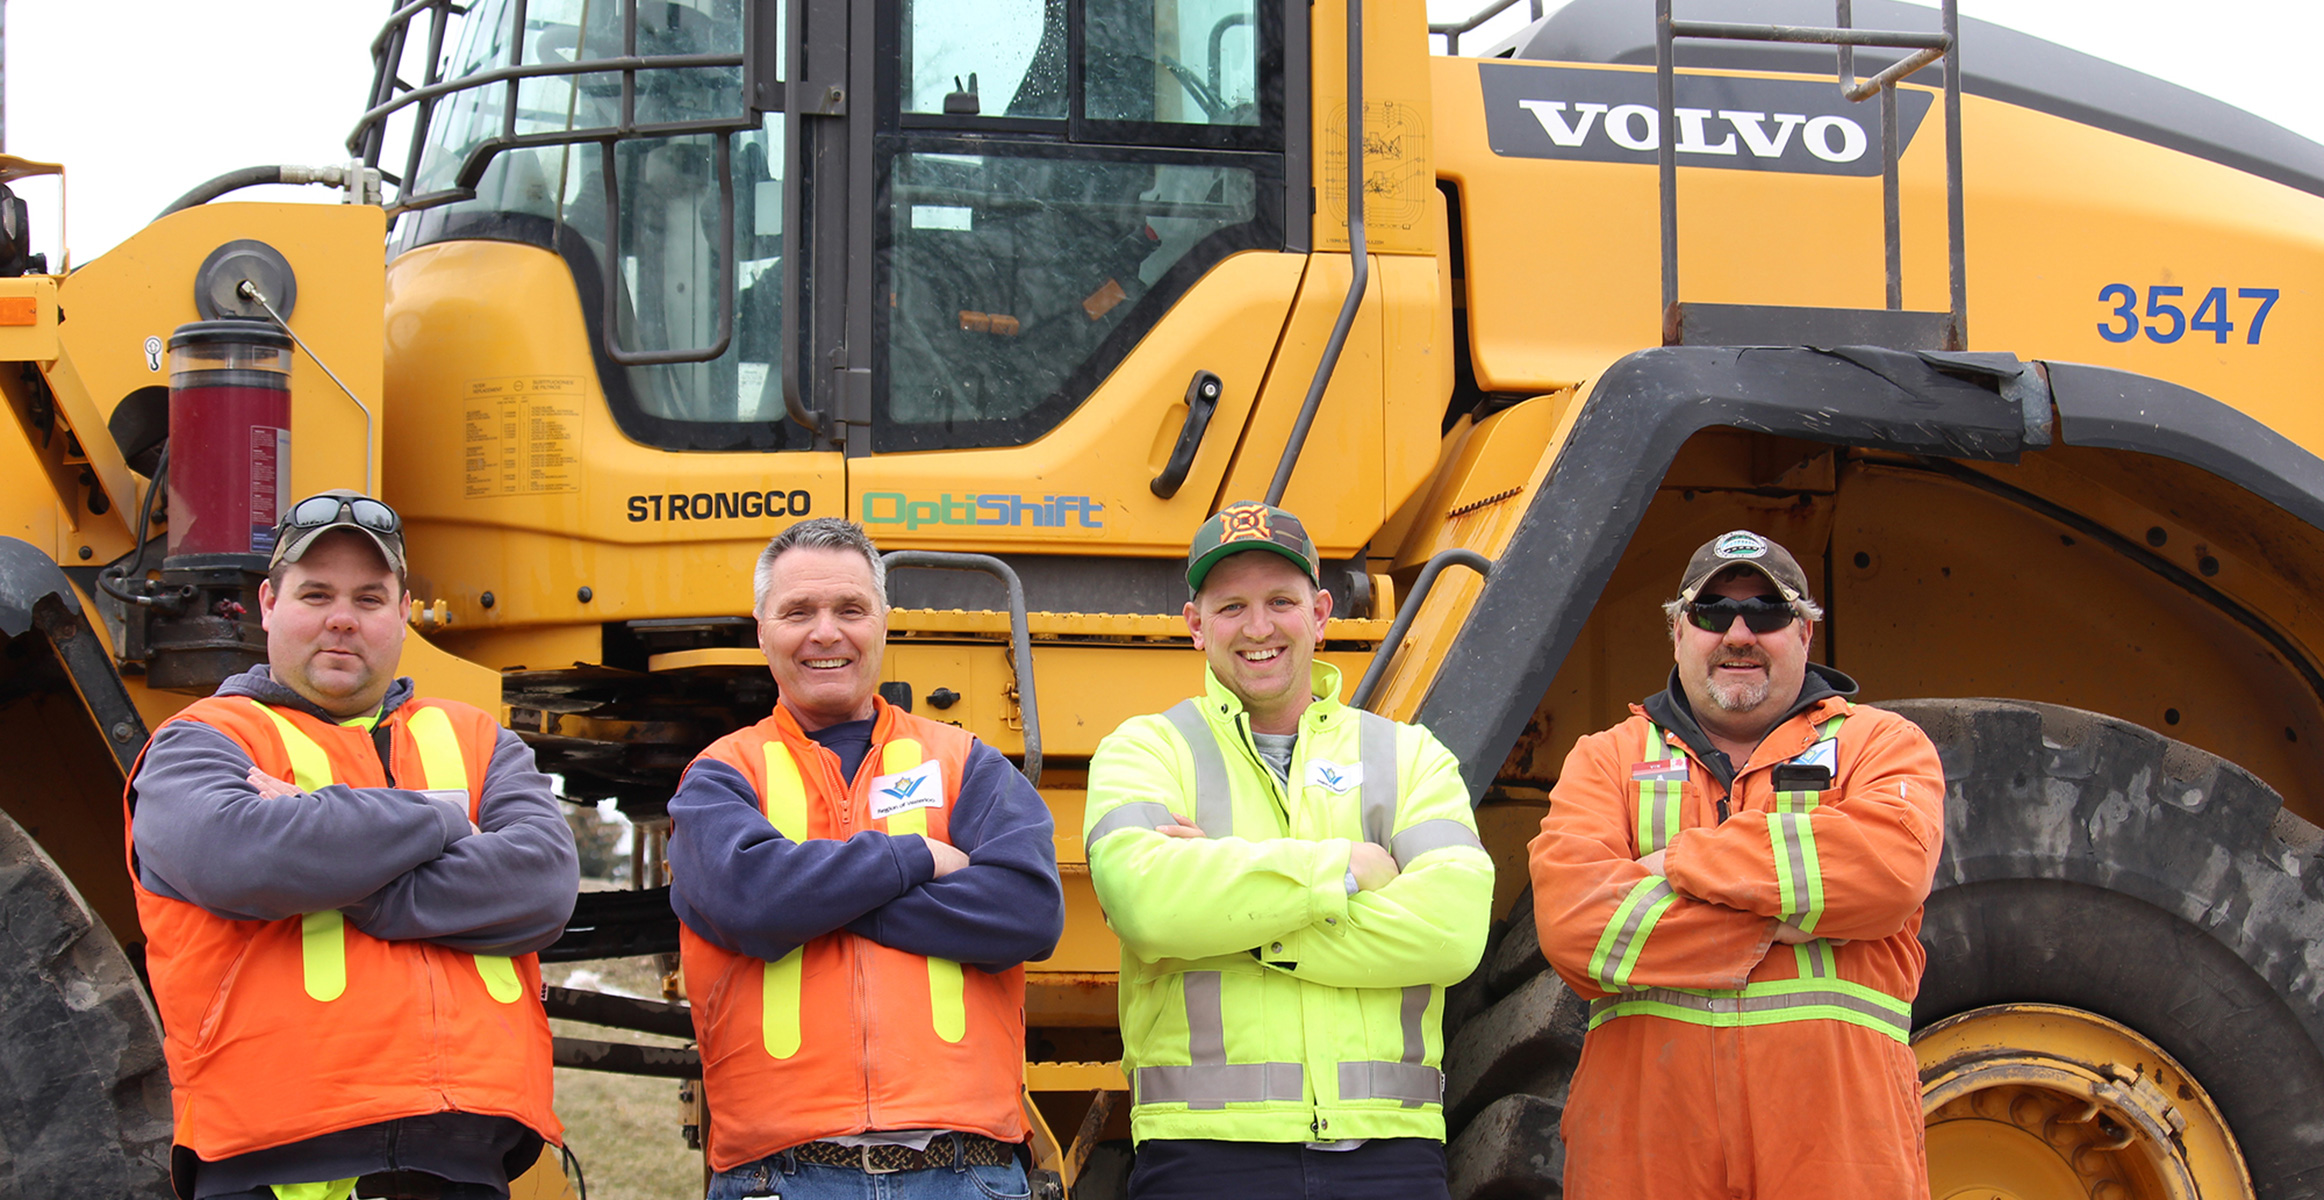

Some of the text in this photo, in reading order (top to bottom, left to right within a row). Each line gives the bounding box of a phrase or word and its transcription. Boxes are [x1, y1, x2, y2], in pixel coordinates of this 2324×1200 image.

[1518, 99, 1868, 163] VOLVO
[2097, 283, 2279, 345] 3547
[627, 490, 811, 522] STRONGCO
[862, 491, 1103, 531] OptiShift
[877, 805, 898, 813] Region
